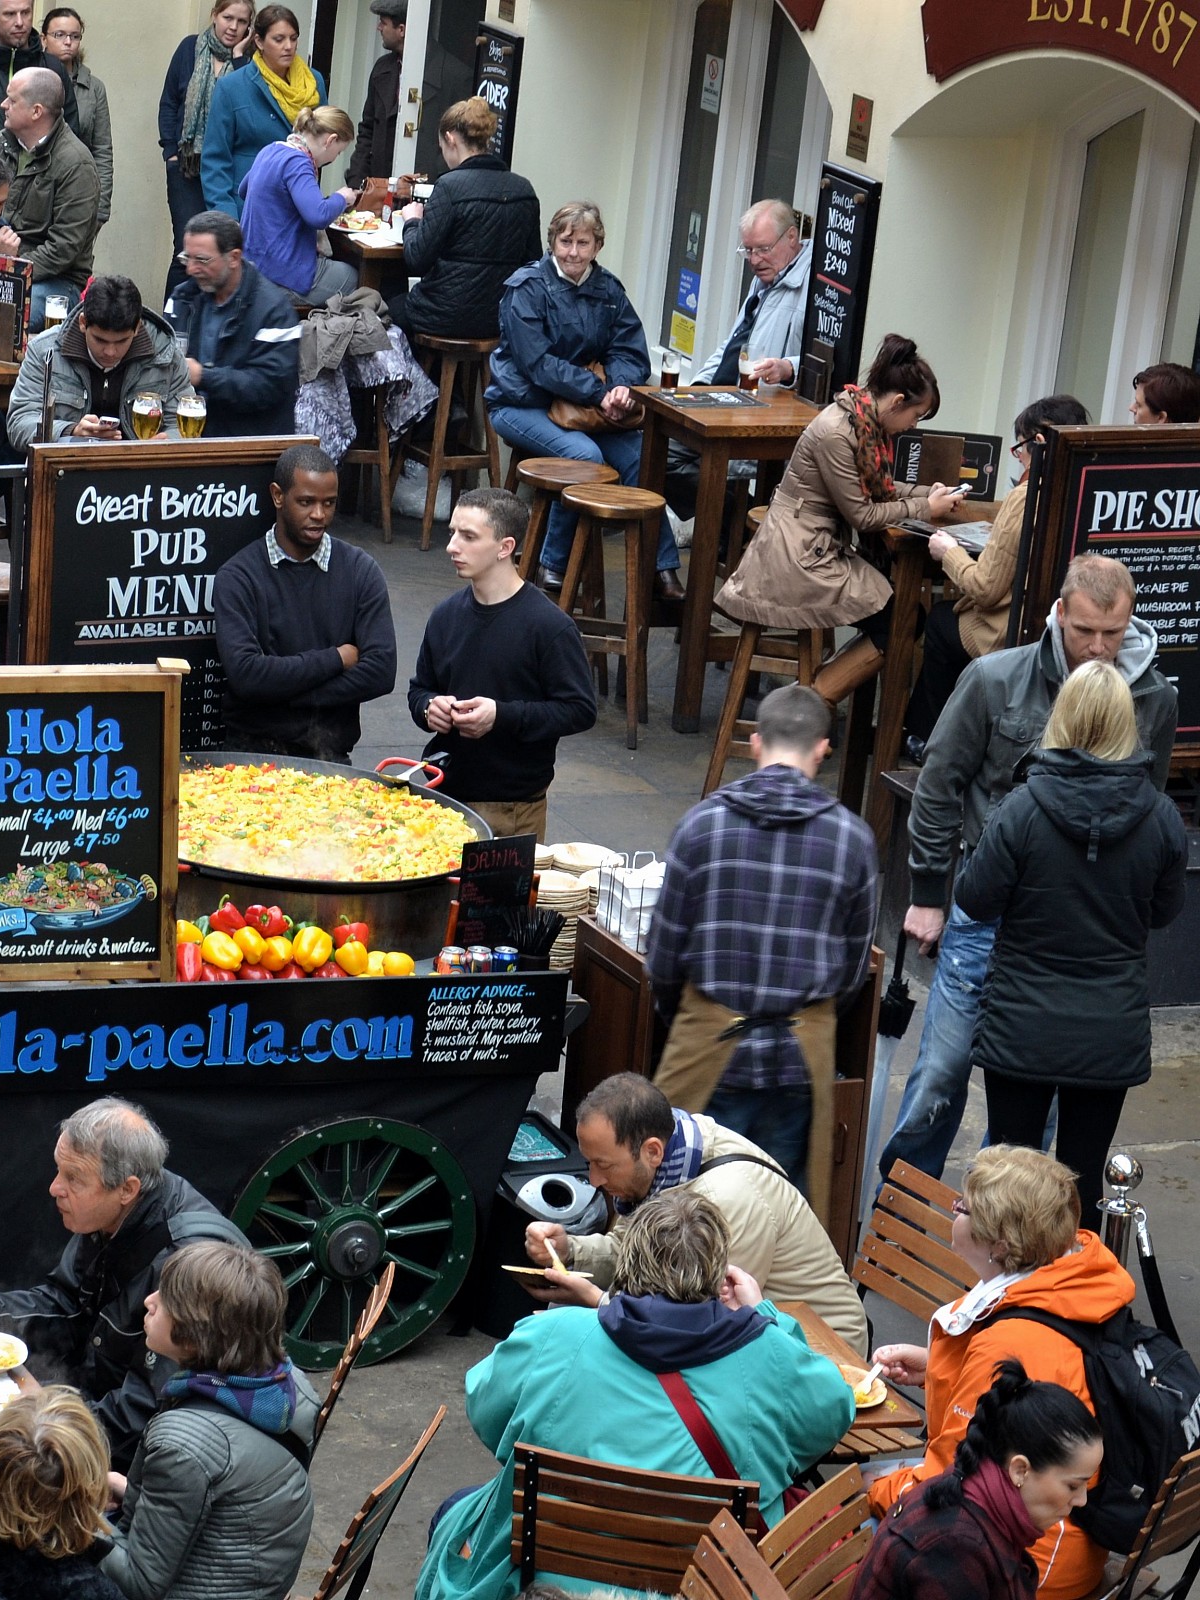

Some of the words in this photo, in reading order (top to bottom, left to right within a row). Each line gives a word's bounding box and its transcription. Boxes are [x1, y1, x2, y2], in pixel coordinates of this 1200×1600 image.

[477, 80, 509, 110] CIDER
[827, 207, 856, 234] Mixed
[825, 230, 852, 256] Olives
[905, 442, 922, 482] DRINKS
[75, 484, 154, 525] Great
[160, 483, 261, 520] British
[1088, 490, 1148, 532] PIE
[130, 527, 208, 569] PUB
[1120, 546, 1166, 555] TRADITIONAL
[1168, 545, 1196, 554] RECIPE
[1150, 583, 1171, 594] ALE
[1171, 581, 1190, 593] PIE
[1135, 601, 1191, 613] MUSHROOM
[78, 621, 178, 639] AVAILABLE
[1158, 634, 1180, 645] SUET
[1181, 633, 1198, 644] PIE
[6, 705, 124, 754] Hola
[72, 808, 107, 833] Med
[20, 834, 71, 864] Large
[56, 938, 101, 958] drinks
[428, 986, 480, 1001] ALLERGY
[427, 1002, 471, 1016] Contains
[506, 1015, 541, 1032] celery
[480, 1030, 504, 1048] May
[503, 1029, 542, 1045] contain
[423, 1048, 458, 1062] traces
[459, 1047, 474, 1060] of
